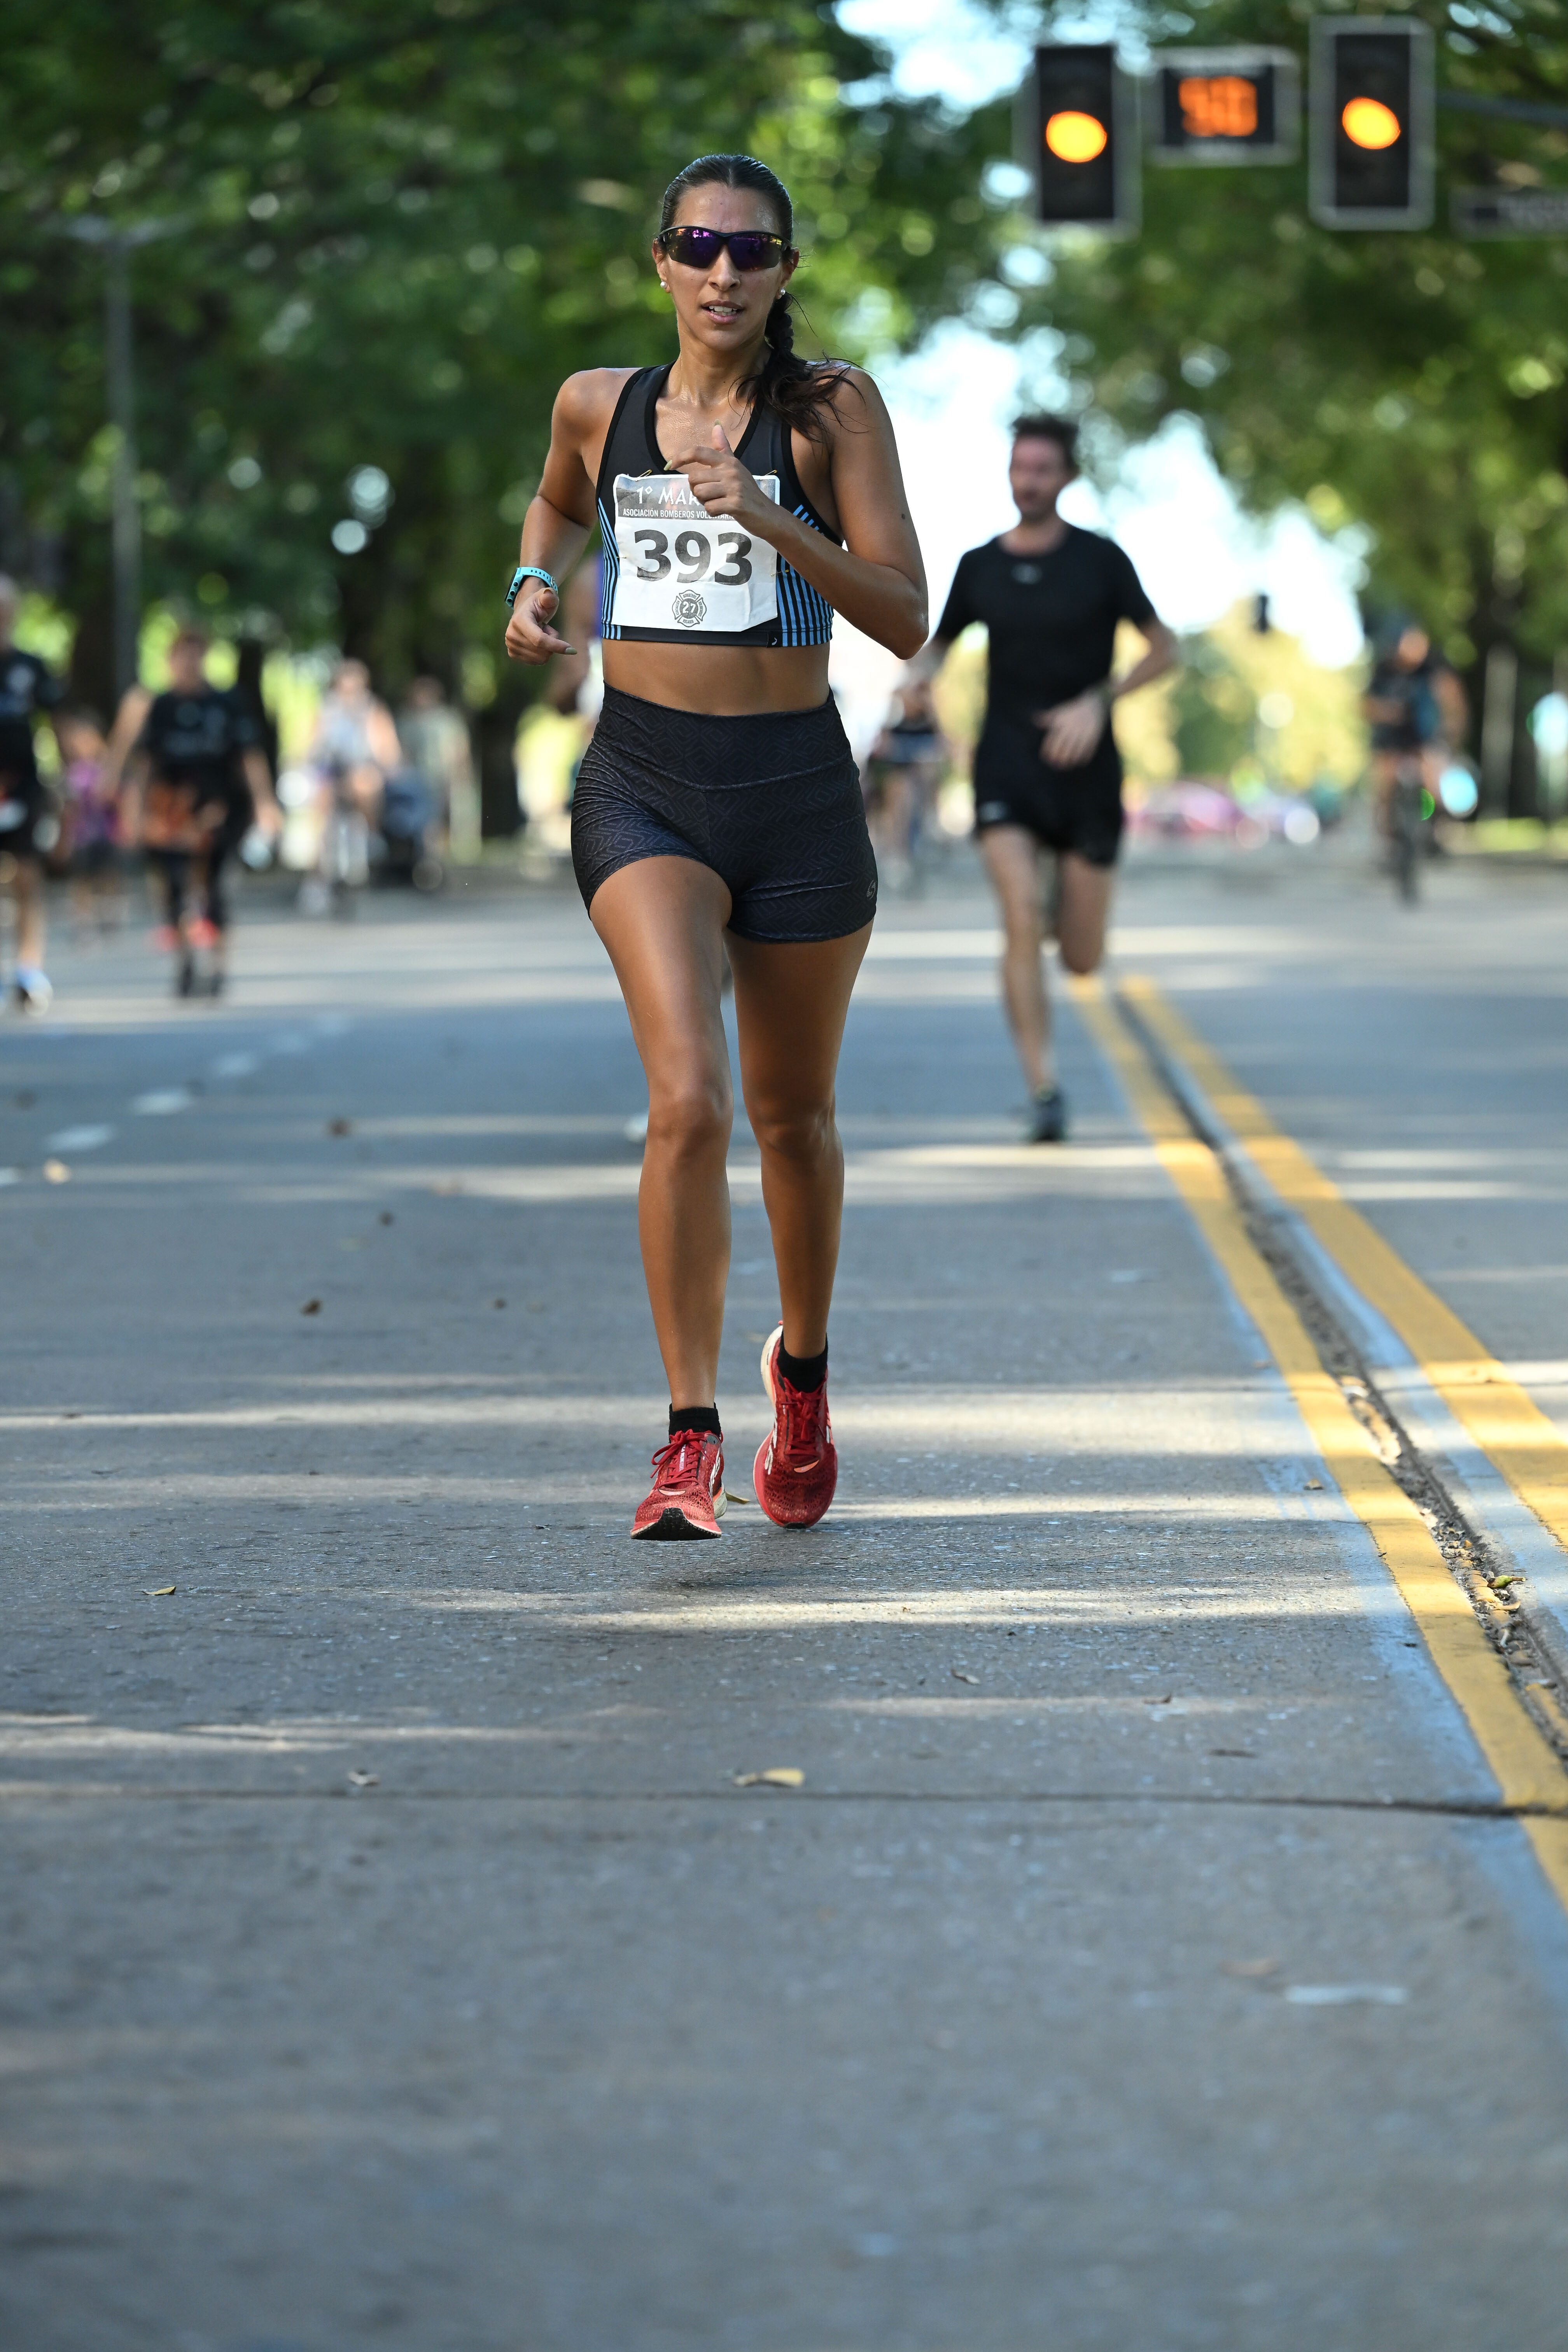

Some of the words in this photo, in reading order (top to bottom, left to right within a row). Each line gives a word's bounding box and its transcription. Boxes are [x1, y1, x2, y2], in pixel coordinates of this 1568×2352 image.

[623, 508, 659, 517] ASOCIACIÓN
[660, 509, 695, 518] BOMBEROS
[634, 529, 752, 586] 393
[682, 601, 696, 614] 27
